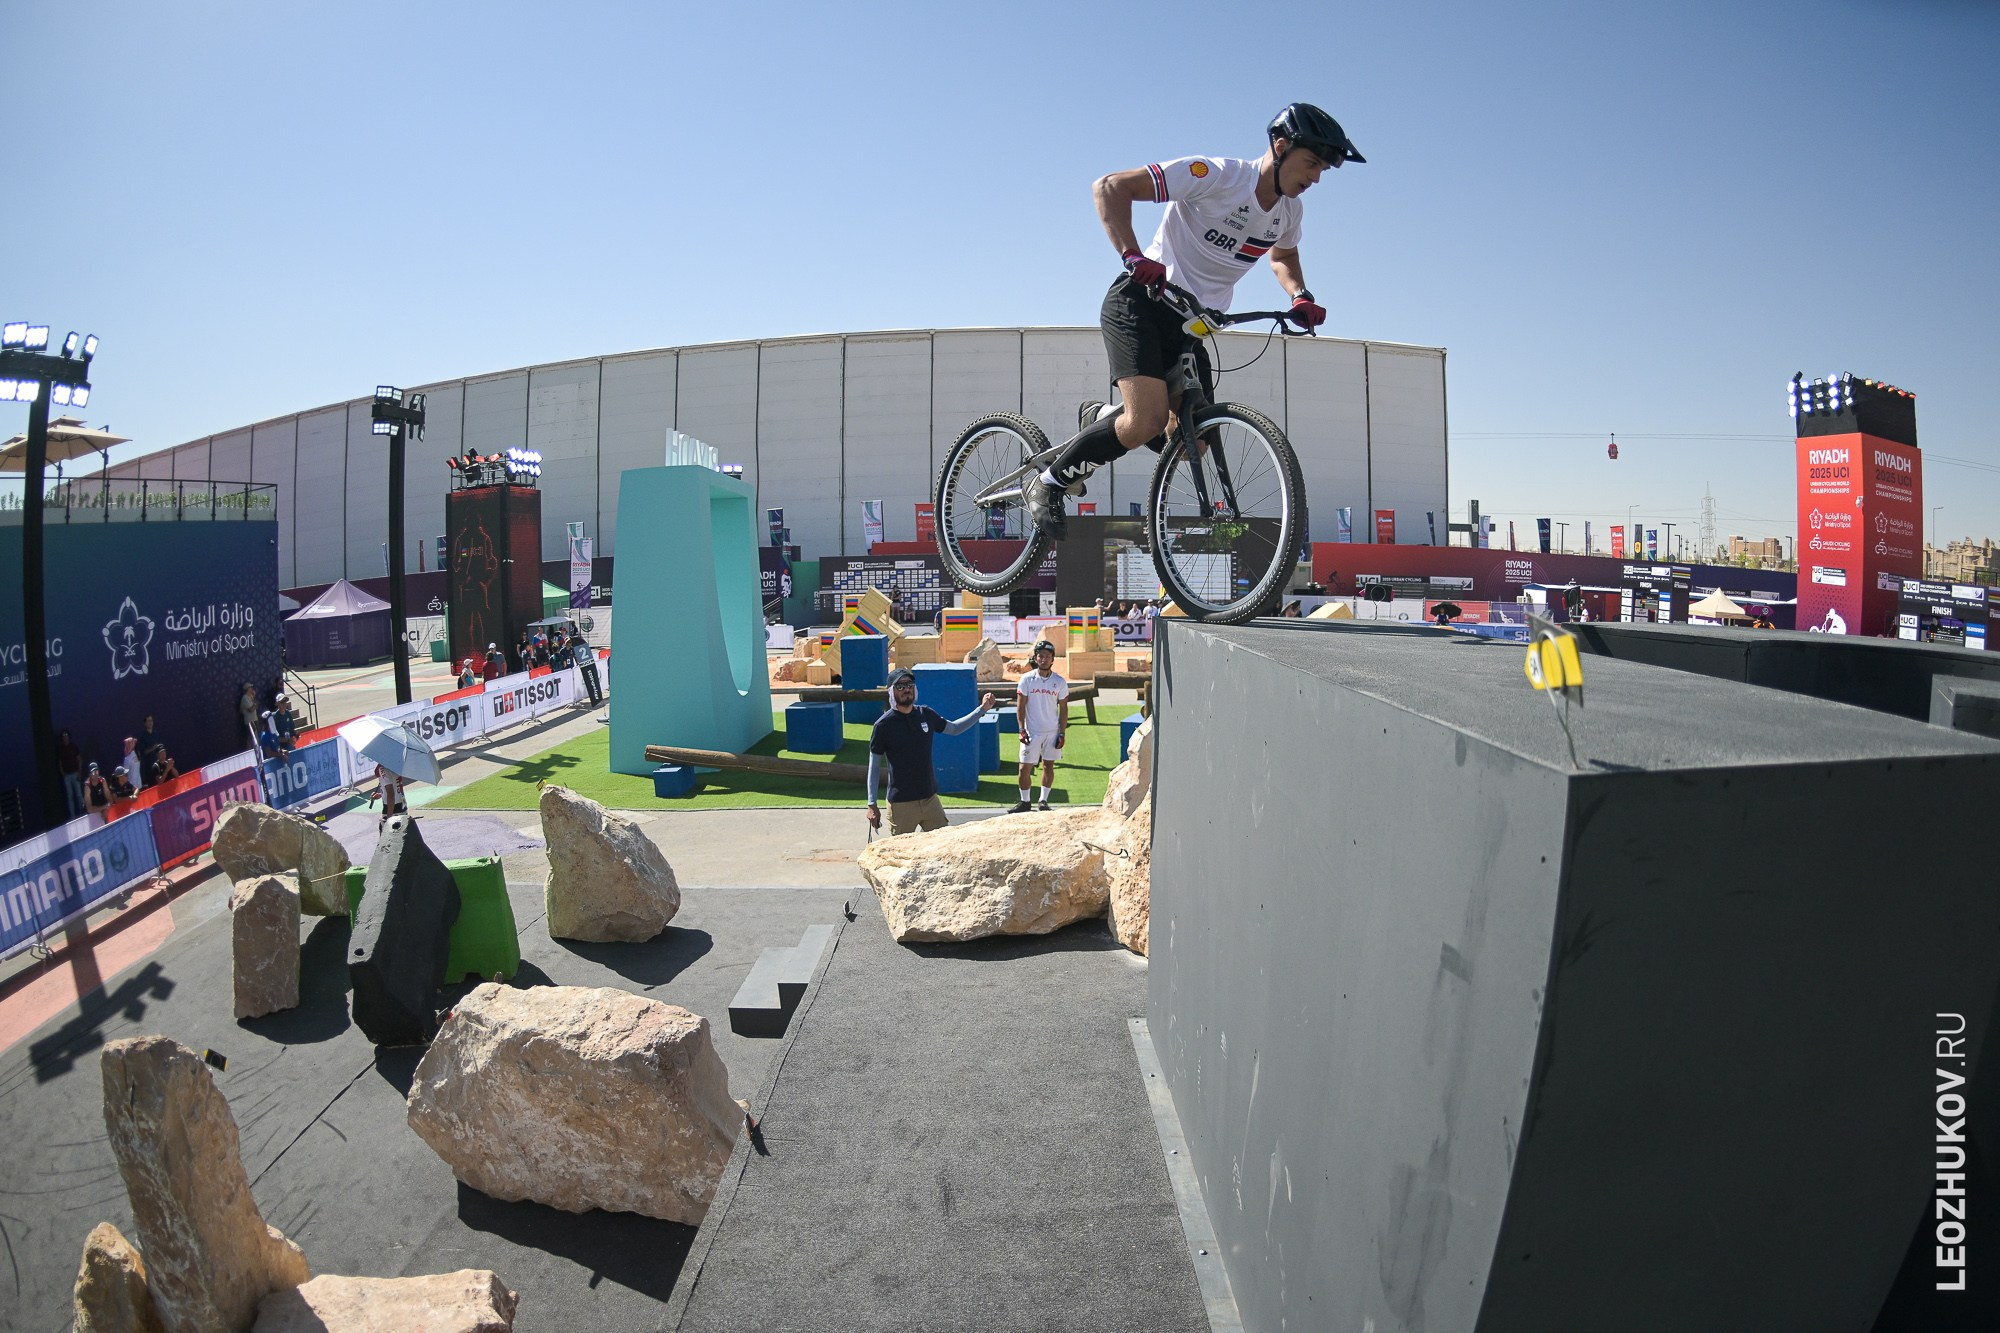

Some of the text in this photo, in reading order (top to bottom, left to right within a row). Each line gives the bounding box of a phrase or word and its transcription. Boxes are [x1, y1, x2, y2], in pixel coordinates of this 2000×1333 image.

[1204, 228, 1237, 251] GBR
[1809, 448, 1849, 465] RIYADH
[1874, 450, 1911, 473] RIYADH
[1810, 466, 1850, 479] 2025 UCI
[1875, 469, 1912, 488] 2025 UCI
[1875, 490, 1912, 503] CHAMPIONSHIPS
[1040, 560, 1057, 568] 025
[1505, 560, 1532, 569] RIYADH
[1521, 569, 1532, 577] UCI
[763, 580, 777, 588] UCI
[1906, 583, 1919, 591] UCI
[1932, 606, 1952, 615] FINISH
[166, 603, 254, 634] وزارة الرياضة
[1904, 617, 1916, 625] UCI
[1100, 623, 1146, 635] SOT
[408, 630, 420, 641] CI
[166, 633, 255, 661] Ministry of Sport
[579, 647, 589, 660] 2
[514, 677, 562, 710] TISSOT
[1030, 688, 1058, 697] JAPAN
